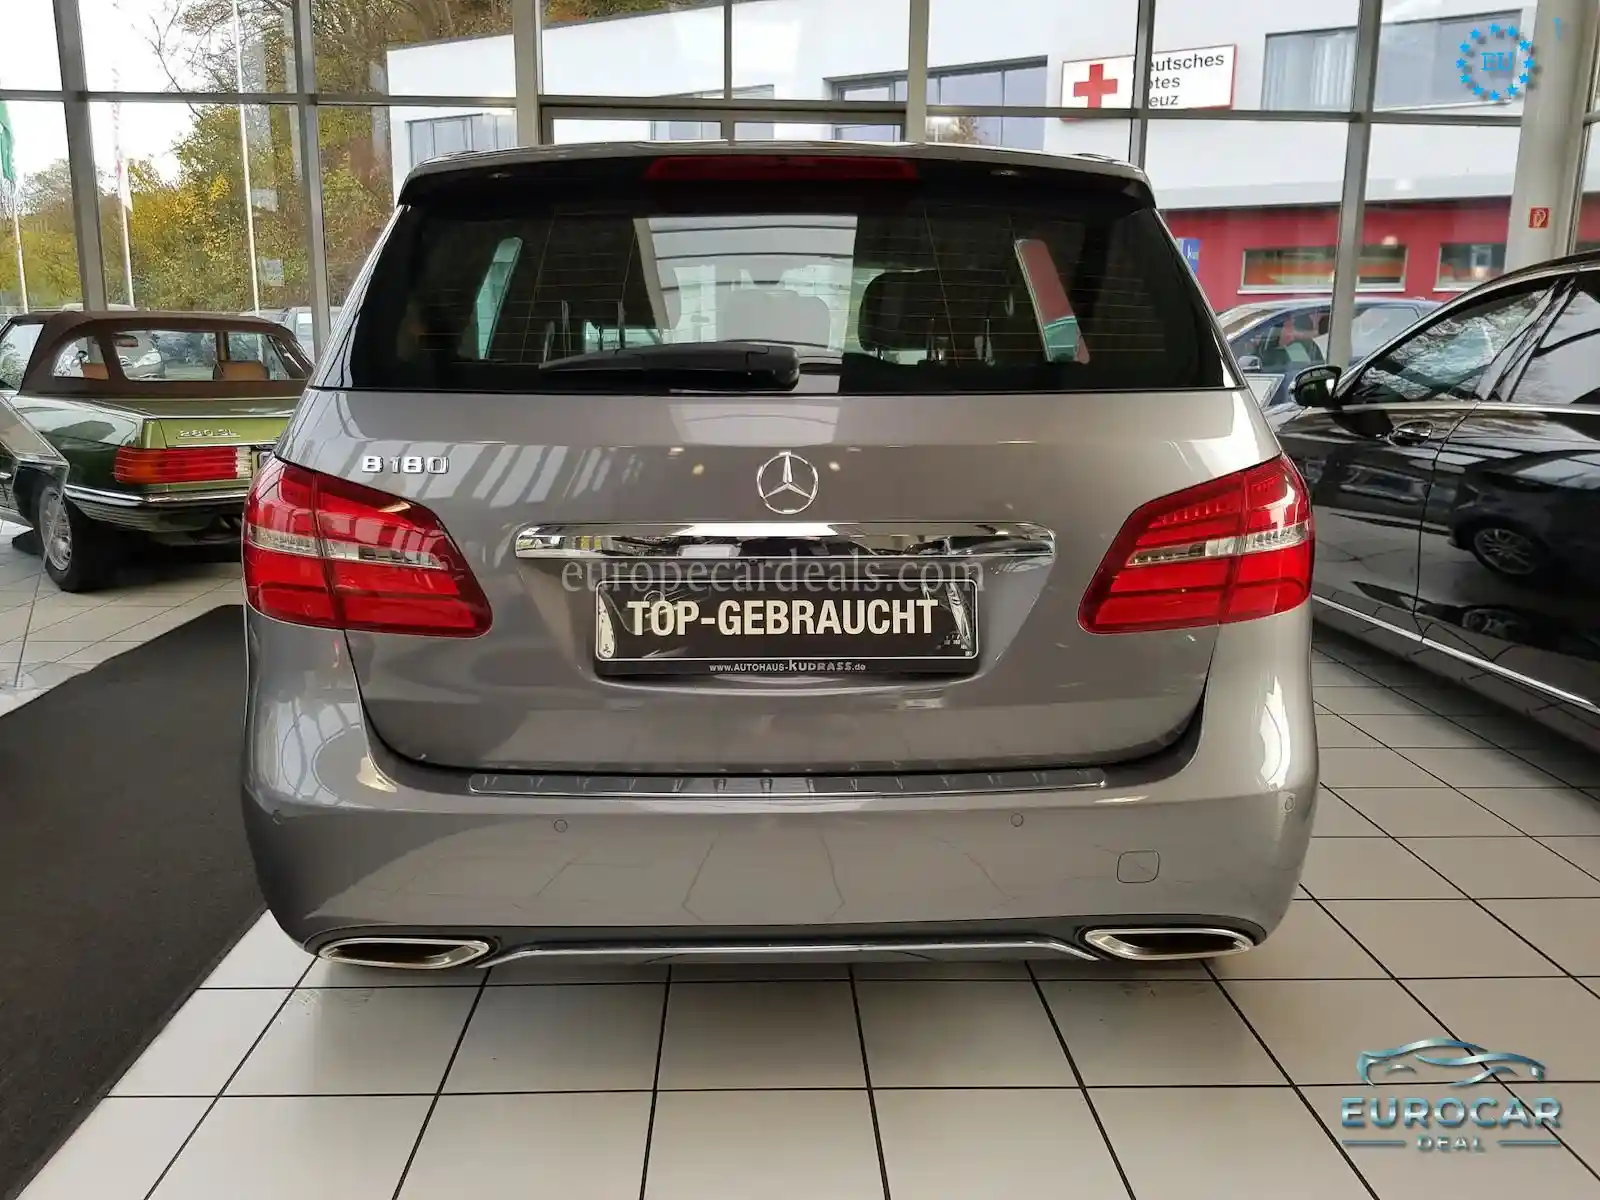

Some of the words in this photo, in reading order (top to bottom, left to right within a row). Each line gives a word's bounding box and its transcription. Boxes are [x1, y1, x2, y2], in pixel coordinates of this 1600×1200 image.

[1151, 53, 1225, 71] utsches
[1149, 76, 1180, 89] tes
[1149, 95, 1179, 107] euz
[361, 455, 384, 473] B
[390, 456, 450, 475] 180
[627, 599, 939, 636] TOP-GEBRAUCHT
[708, 659, 866, 674] www.AUTOHAUS-KUDRASS.de
